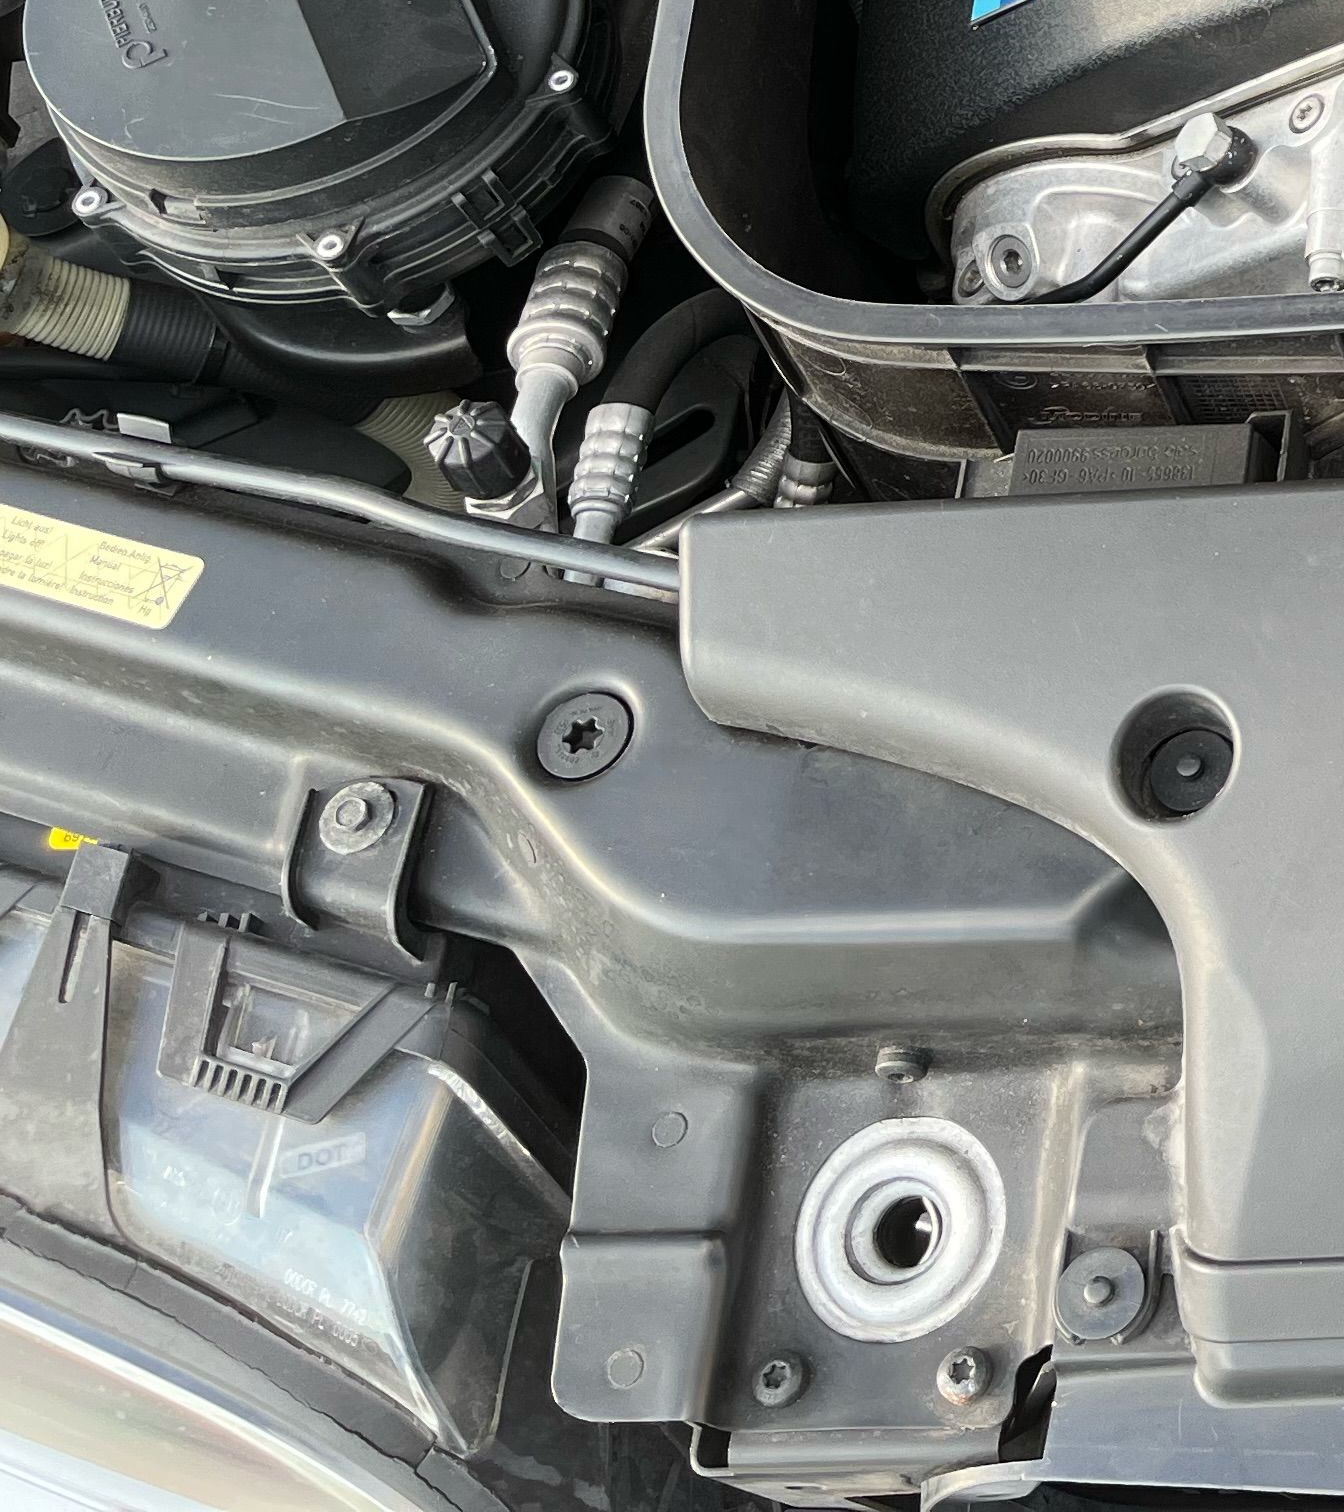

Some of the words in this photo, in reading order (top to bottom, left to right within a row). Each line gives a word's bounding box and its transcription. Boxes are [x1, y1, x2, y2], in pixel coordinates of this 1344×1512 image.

[89, 554, 121, 571] Manual
[78, 570, 136, 594] Instrucciones
[69, 584, 114, 606] Instruction
[139, 604, 152, 617] Hg
[296, 1143, 349, 1171] DOT
